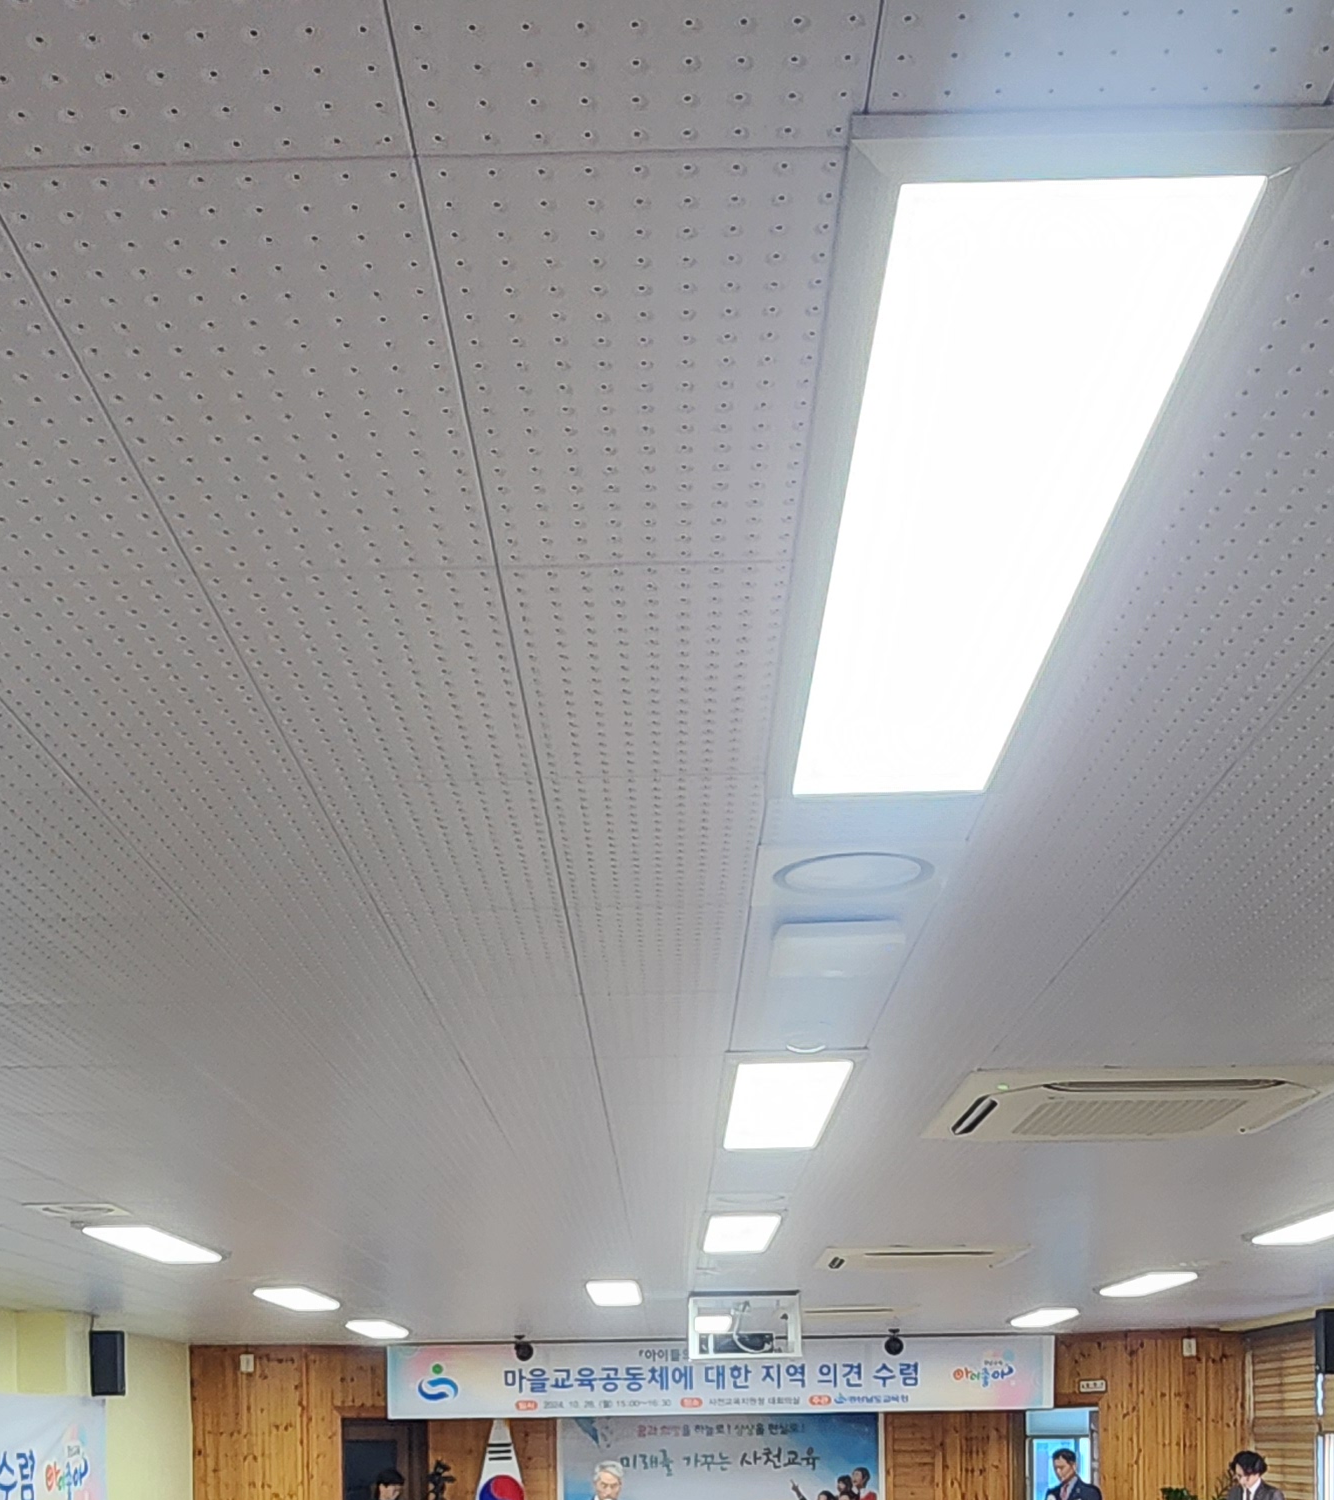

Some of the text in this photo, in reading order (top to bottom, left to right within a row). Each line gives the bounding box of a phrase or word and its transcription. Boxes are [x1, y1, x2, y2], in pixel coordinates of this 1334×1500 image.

[503, 1360, 920, 1393] 마을교육공동체에 대한 지역 의견 수렴
[620, 1446, 821, 1477] 미래를 가꾸는 사천교육
